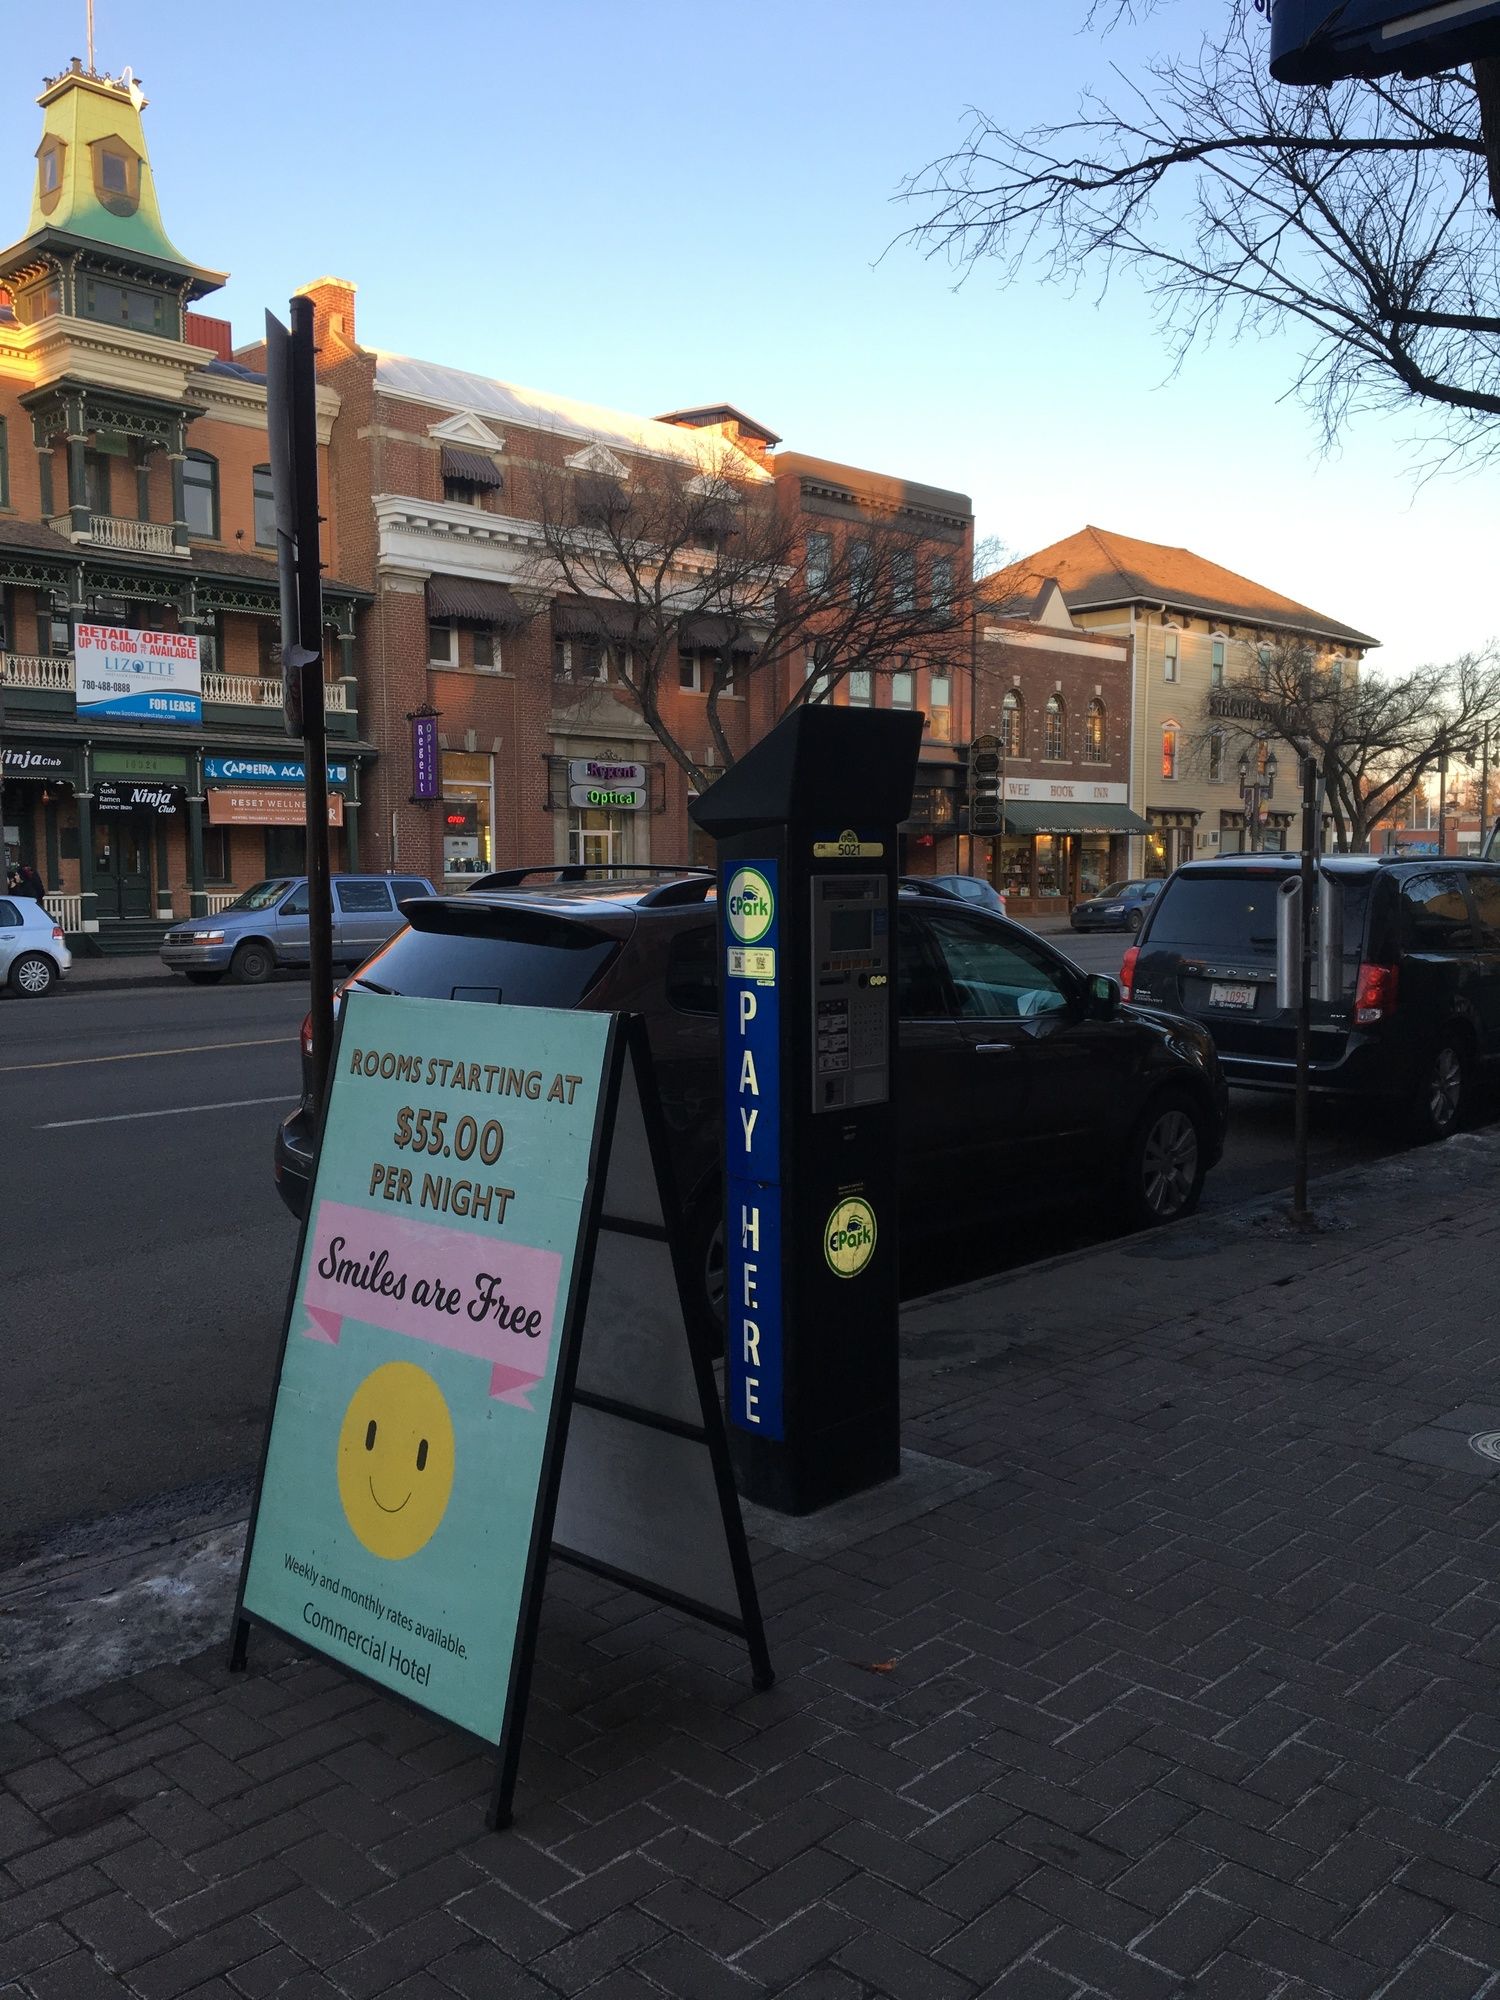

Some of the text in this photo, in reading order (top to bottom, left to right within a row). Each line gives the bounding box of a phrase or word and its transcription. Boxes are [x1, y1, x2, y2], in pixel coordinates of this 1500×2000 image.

[78, 624, 133, 641] RETAIL
[78, 637, 137, 653] UP TO 6,000
[150, 644, 197, 660] AVAILABLE
[104, 656, 175, 675] LIZOTTE
[149, 698, 196, 713] FOR LEASE
[42, 758, 61, 767] Club
[416, 724, 425, 792] Regent
[99, 787, 117, 795] Sushi
[99, 795, 121, 803] Ramen
[130, 788, 172, 807] Ninja
[588, 789, 637, 805] Optical
[1009, 783, 1030, 796] WEE
[1050, 785, 1075, 798] BOOK
[1093, 786, 1109, 799] INN
[157, 804, 177, 814] Club
[231, 798, 265, 808] RESET
[838, 844, 861, 856] 5021
[350, 1048, 583, 1105] ROOMS STARTING AT
[393, 1105, 504, 1166] $55.00
[369, 1162, 515, 1225] PER NIGHT
[739, 989, 761, 1425] PAY HERE
[318, 1236, 542, 1338] Smiles are Free
[284, 1552, 319, 1587] Weekly
[319, 1575, 341, 1594] and
[341, 1586, 386, 1621] monthly
[387, 1607, 414, 1632] rates
[303, 1601, 432, 1688] Commercial Hotel
